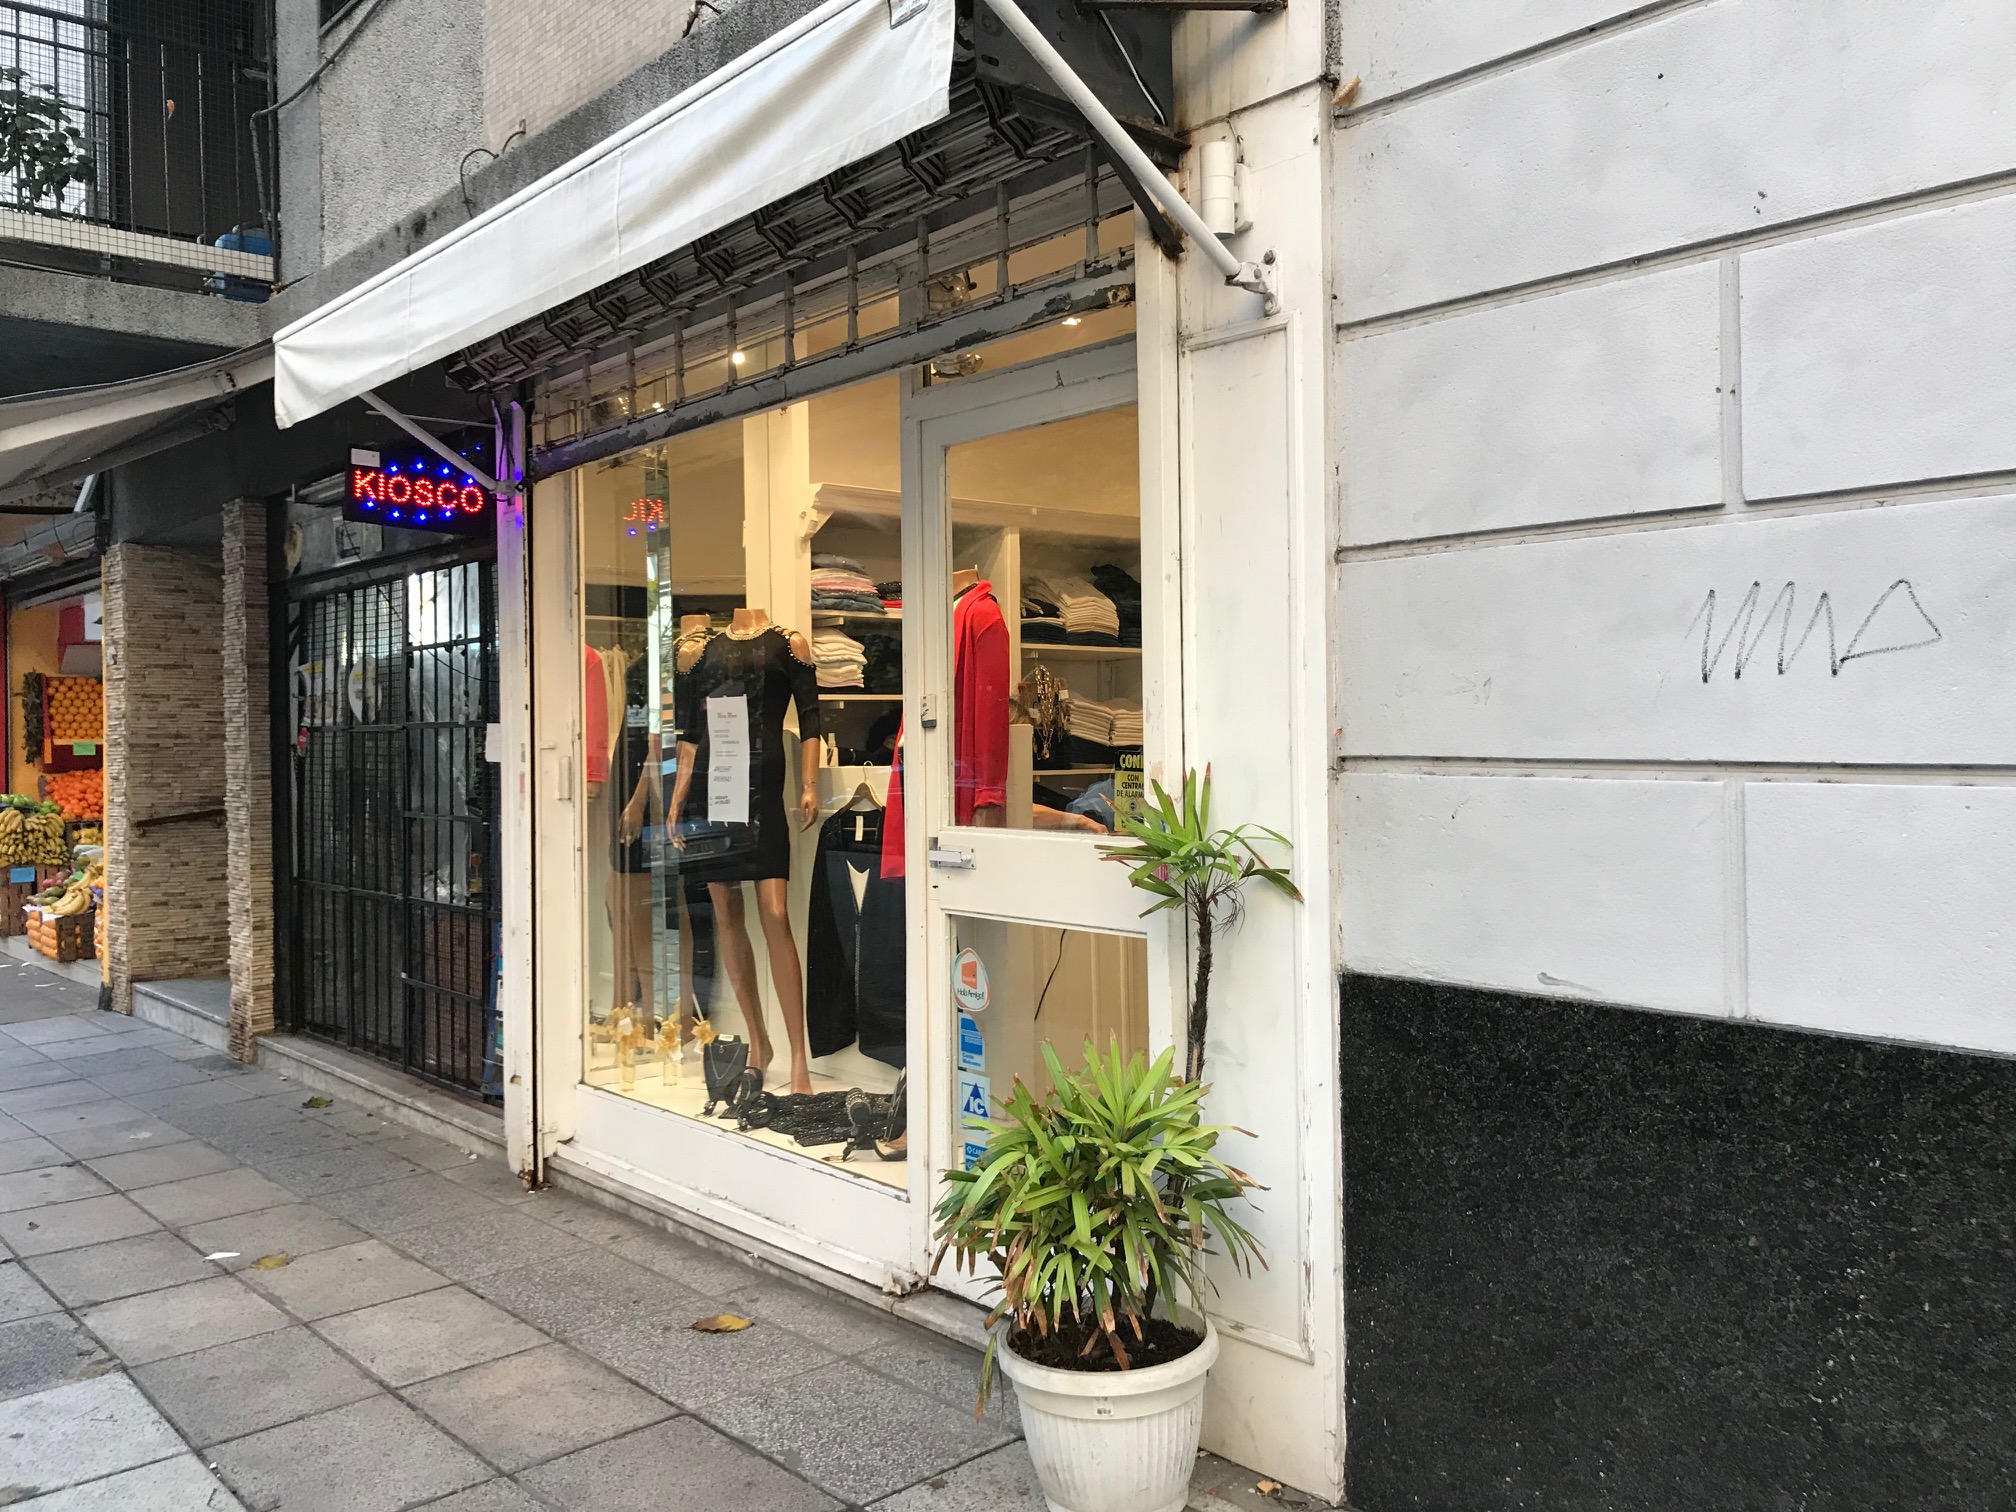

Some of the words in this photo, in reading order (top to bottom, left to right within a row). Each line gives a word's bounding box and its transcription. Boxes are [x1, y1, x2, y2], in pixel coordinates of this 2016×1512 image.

[353, 468, 484, 514] KIOSCO
[1127, 773, 1140, 782] CON
[1116, 789, 1124, 797] DE
[969, 1096, 985, 1115] IC
